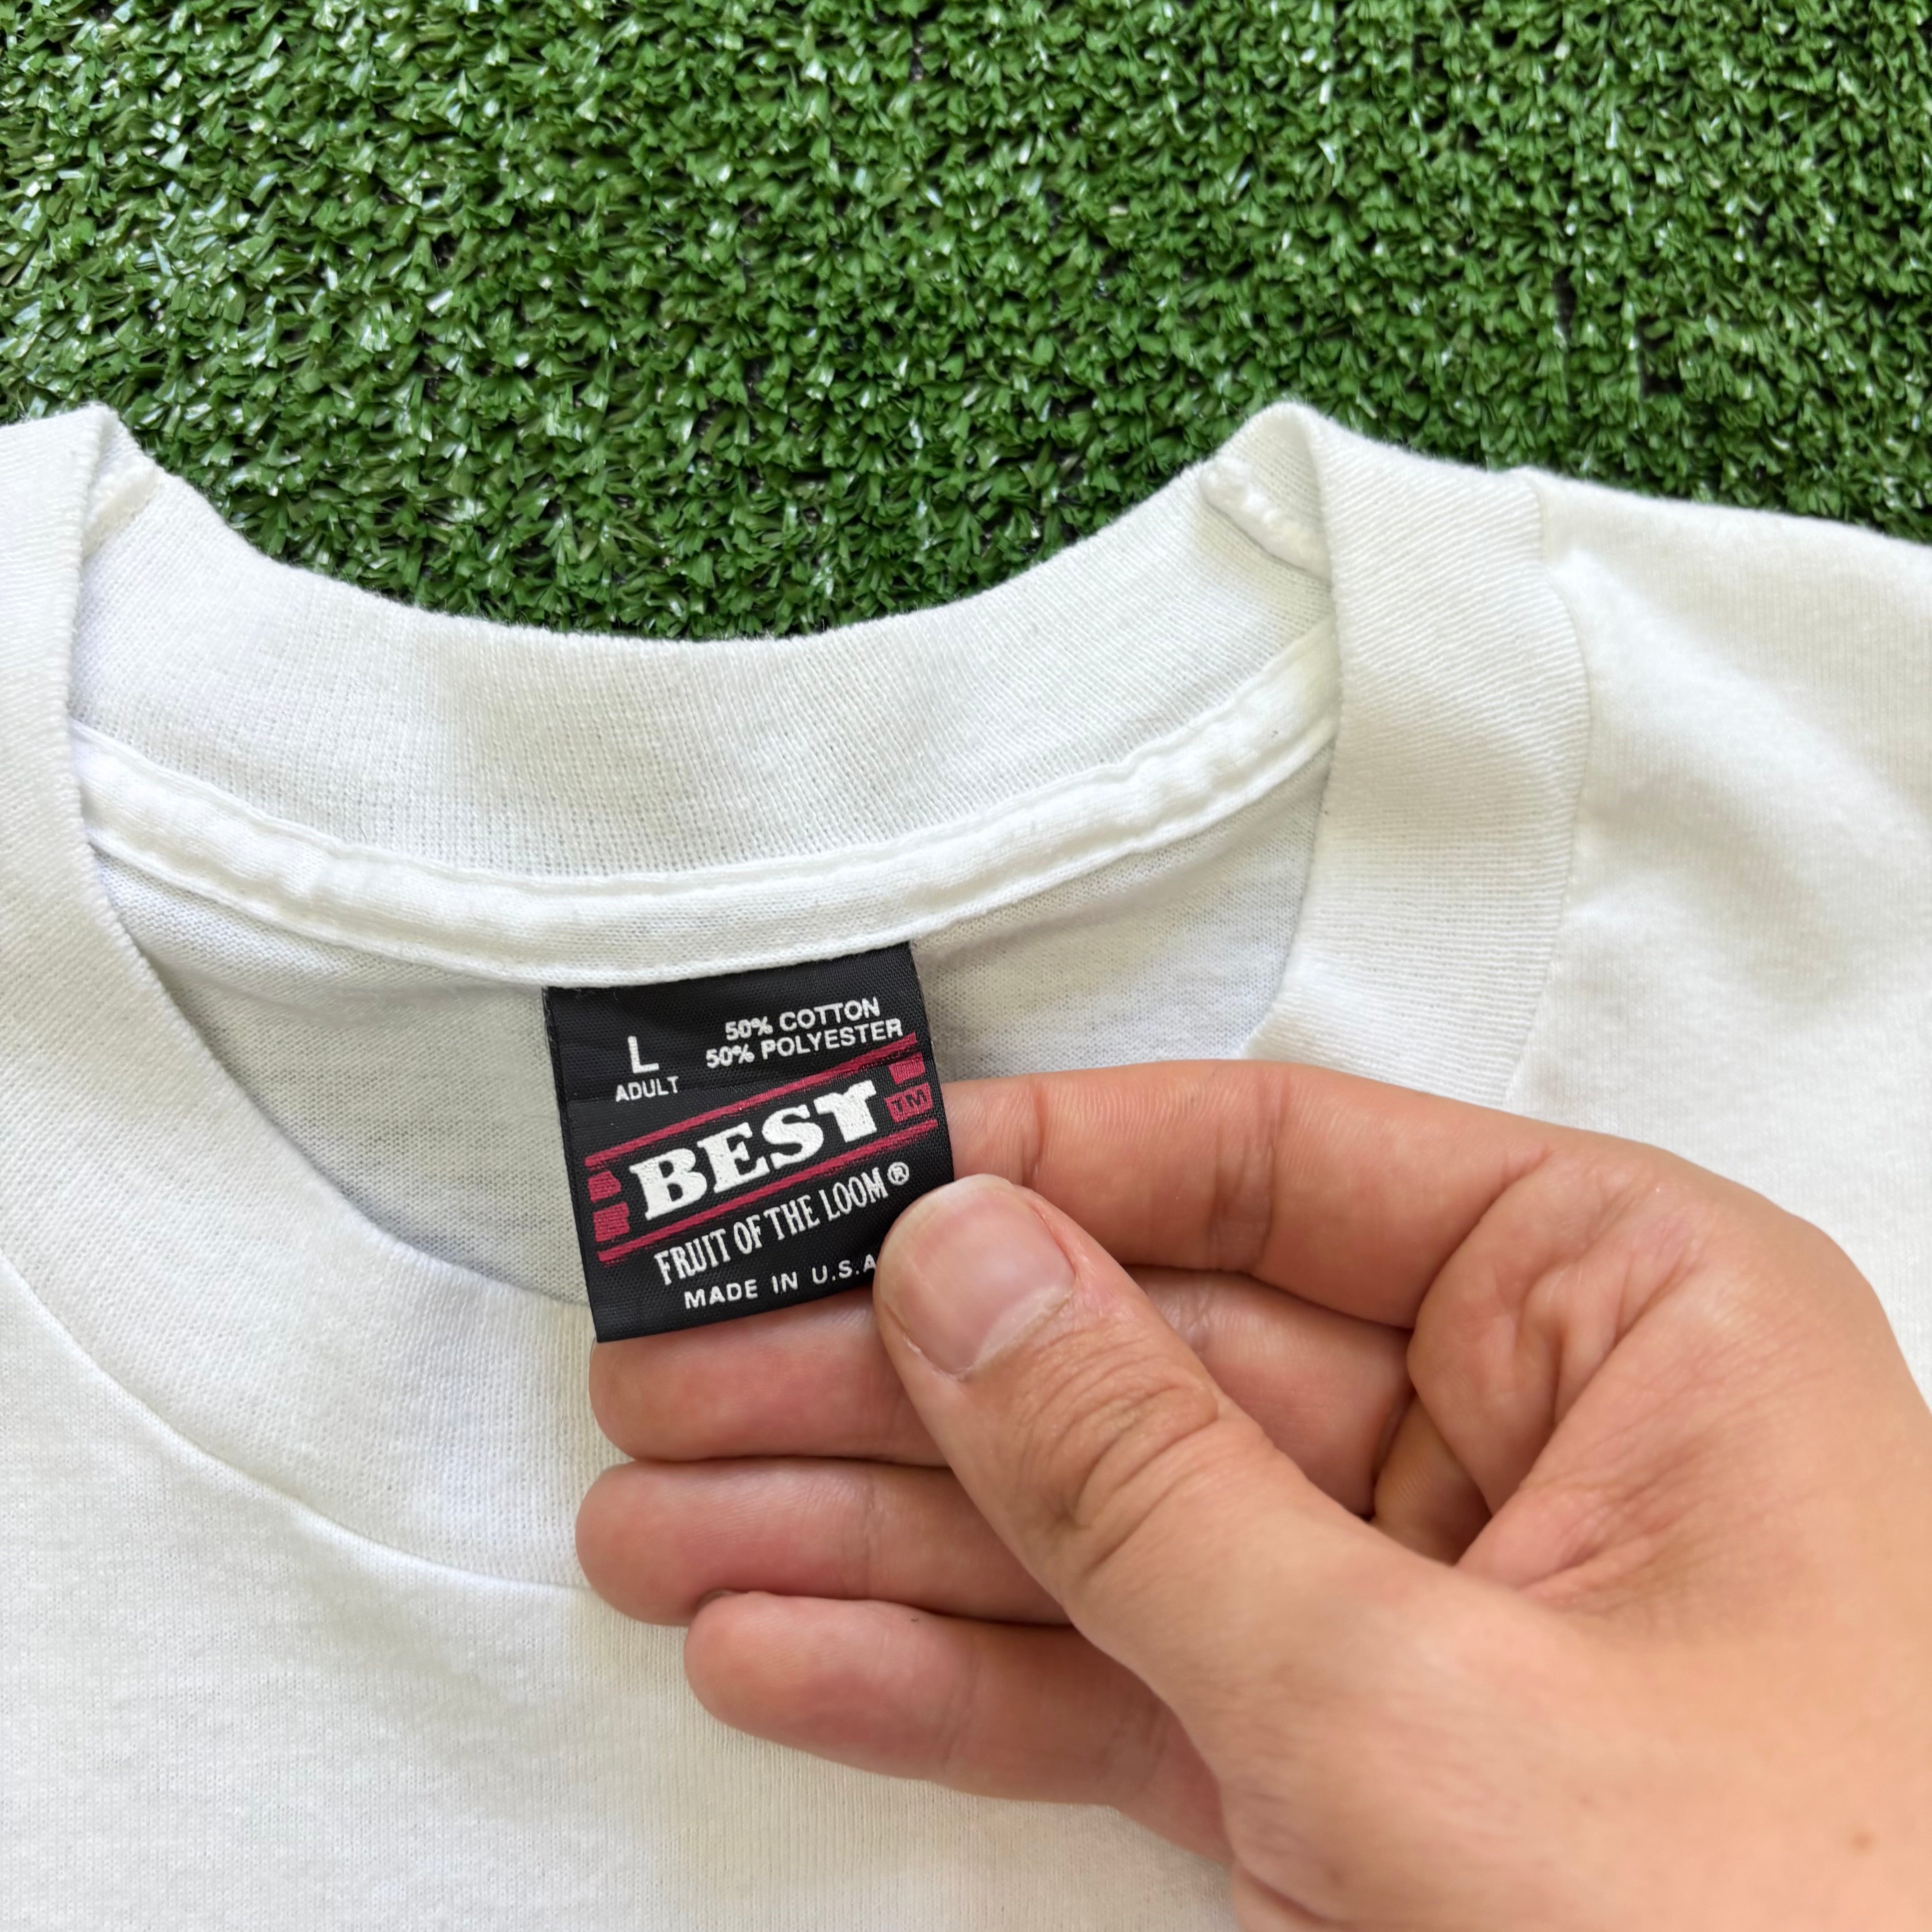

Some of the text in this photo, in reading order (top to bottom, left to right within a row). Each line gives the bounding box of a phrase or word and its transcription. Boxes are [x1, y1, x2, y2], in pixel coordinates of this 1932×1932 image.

[725, 997, 880, 1041] 50% COTTON
[627, 1036, 659, 1074] L
[706, 1018, 903, 1068] 50% POLYESTER
[616, 1076, 679, 1102] ADULT
[629, 1080, 878, 1220] BEST
[654, 1228, 730, 1285] FRUIT
[733, 1216, 762, 1254] OF
[764, 1195, 820, 1240] THE
[684, 1279, 758, 1309] MADE
[772, 1272, 798, 1293] IN
